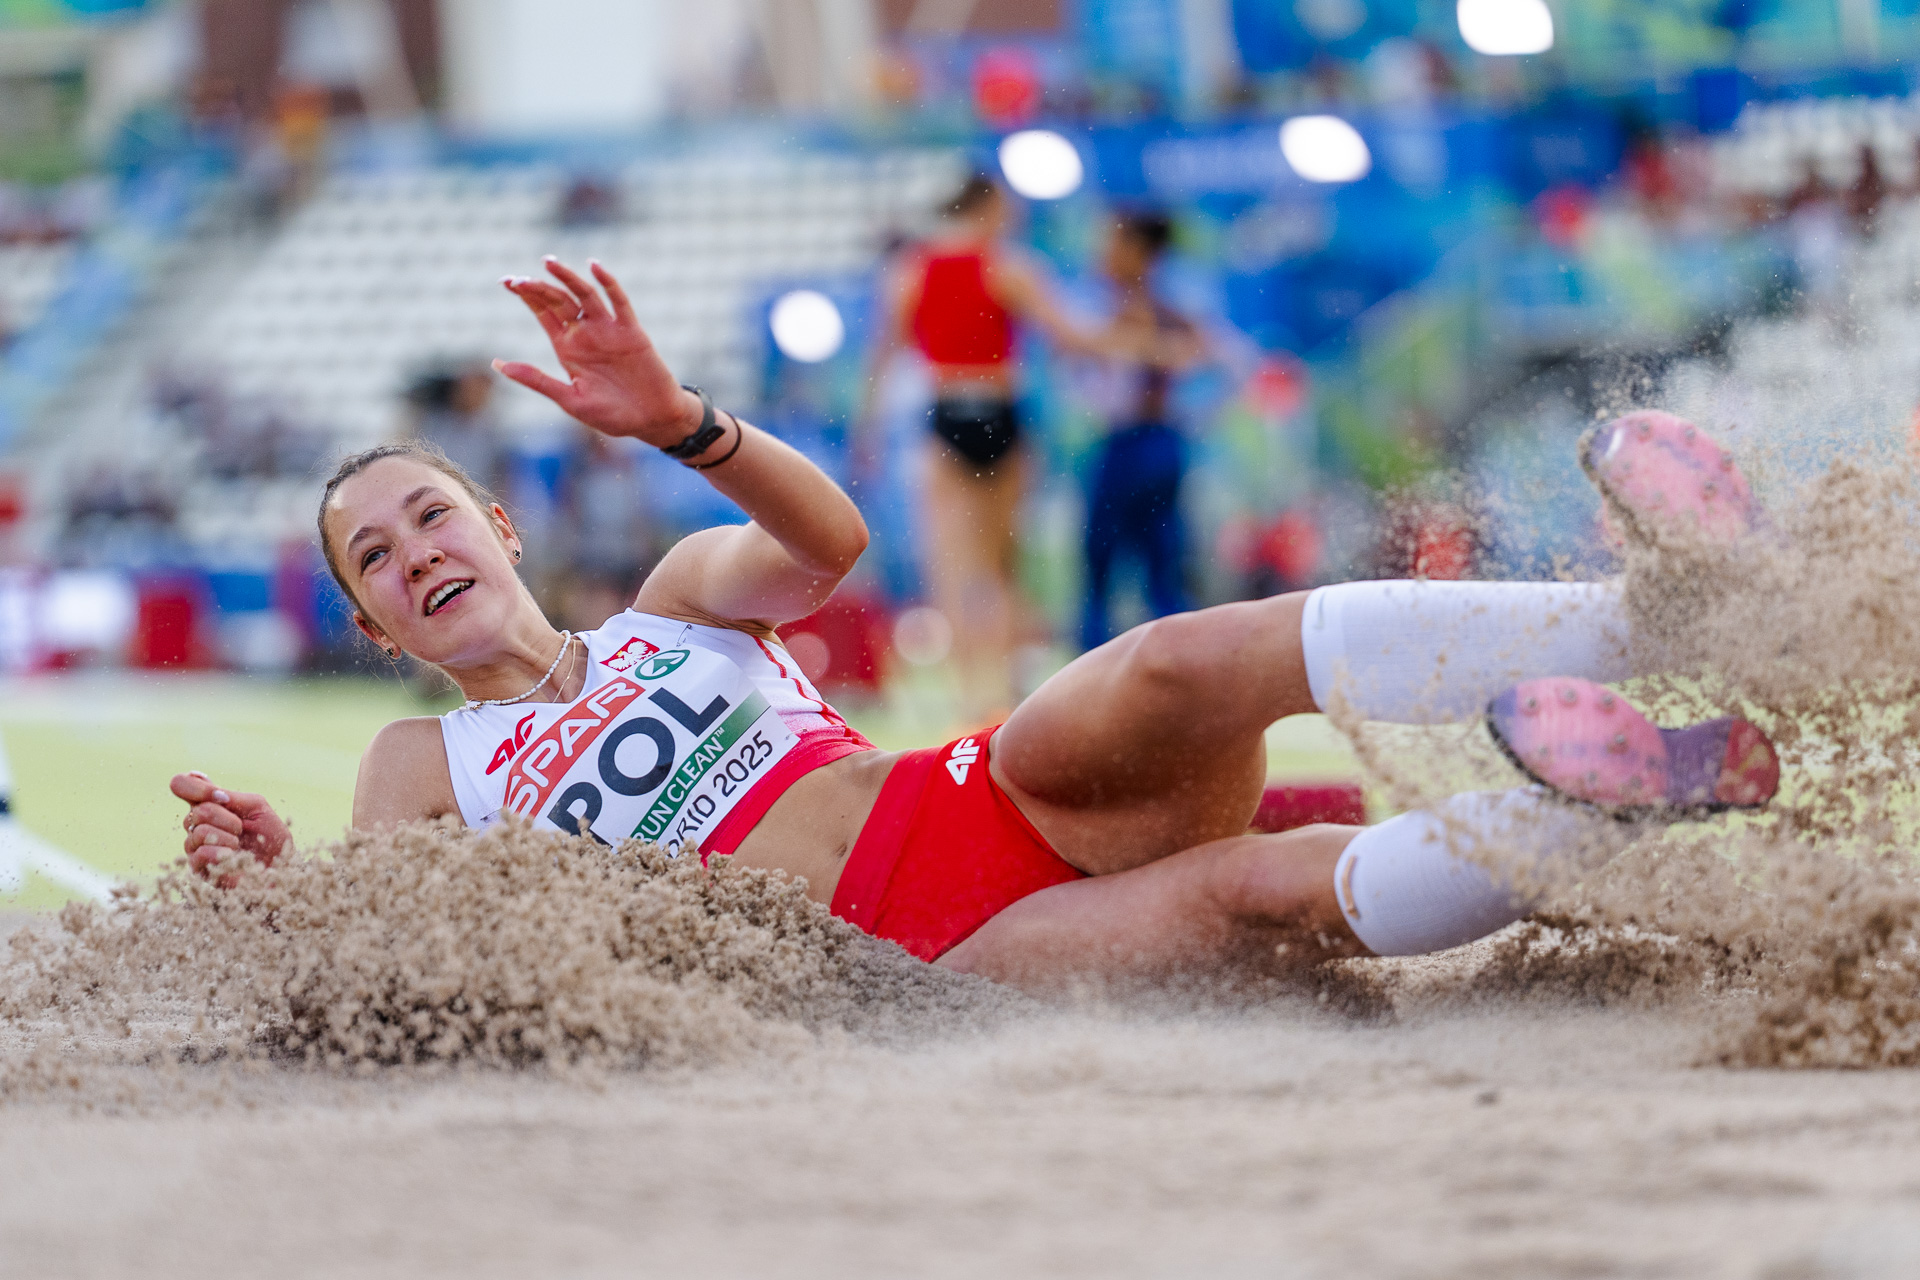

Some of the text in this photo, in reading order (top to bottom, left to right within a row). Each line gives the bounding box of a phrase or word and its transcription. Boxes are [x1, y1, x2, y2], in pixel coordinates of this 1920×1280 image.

[508, 682, 637, 823] SPAR
[547, 687, 731, 849] POL
[713, 730, 773, 798] 2025
[631, 801, 674, 844] RUN
